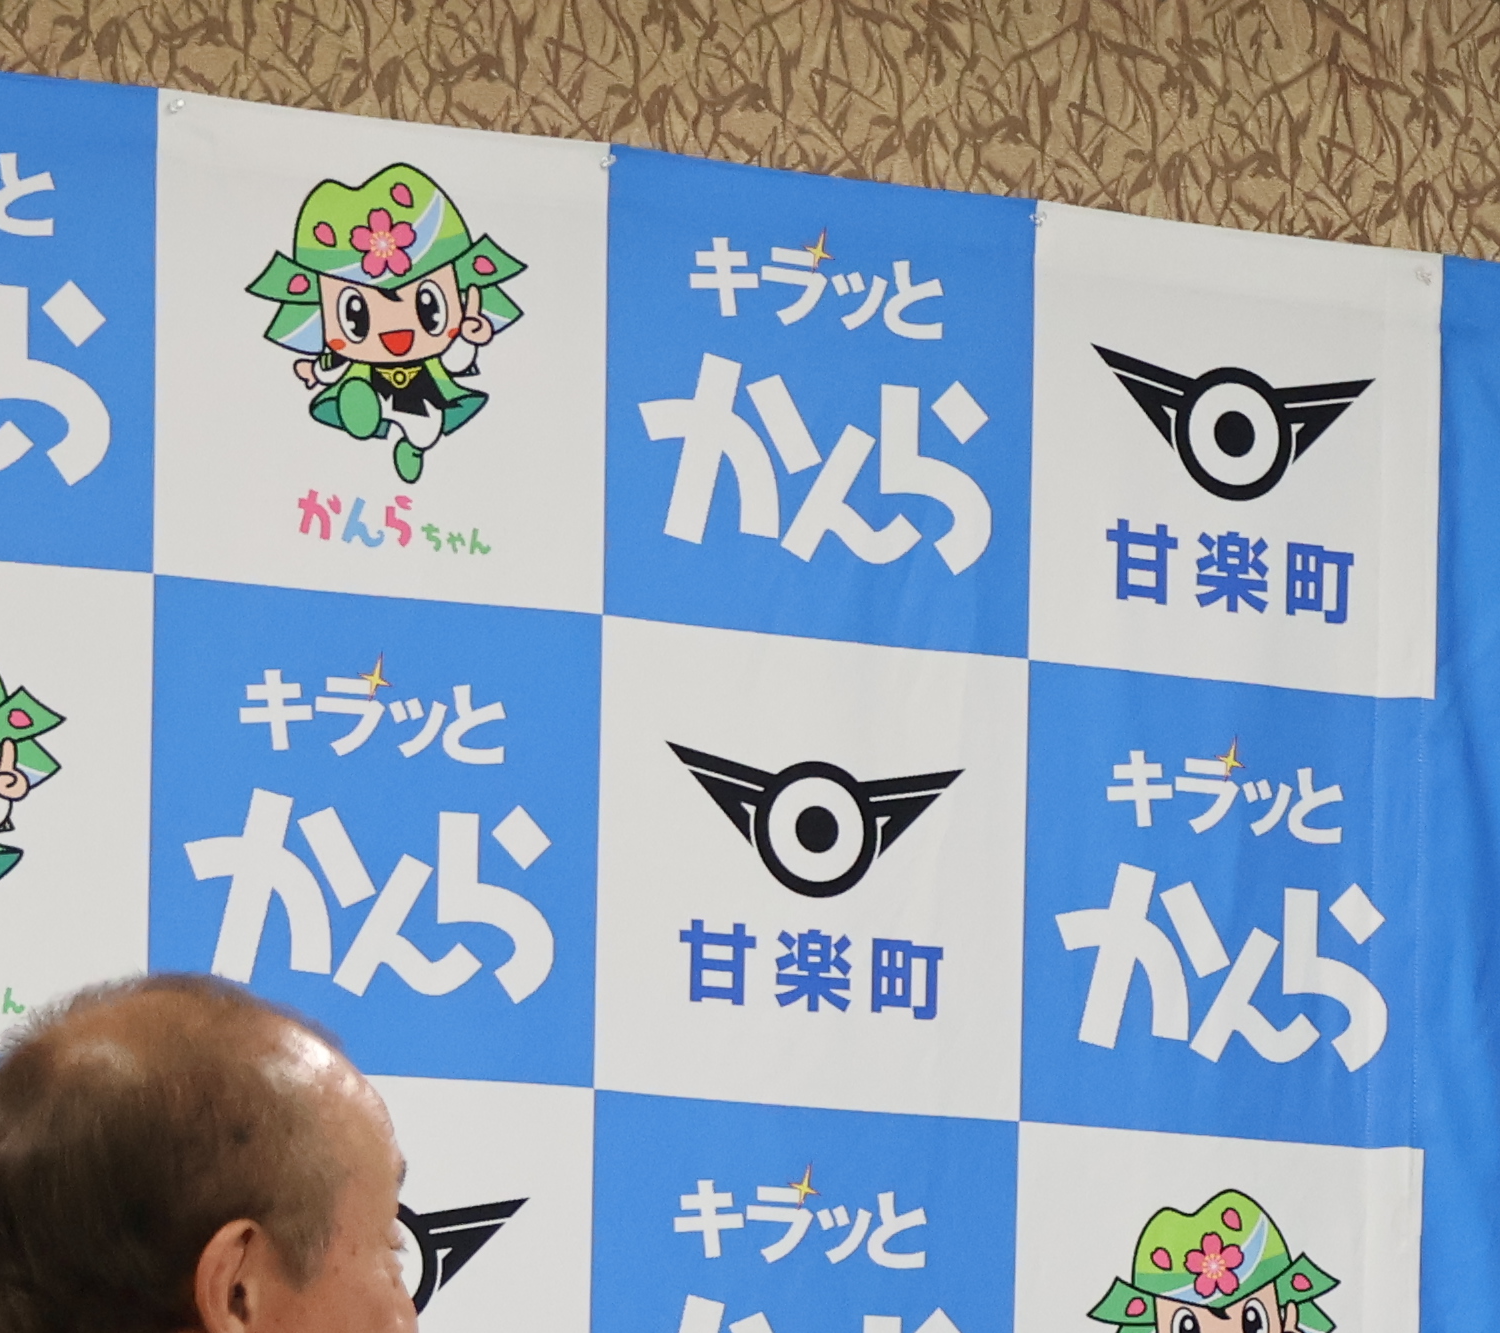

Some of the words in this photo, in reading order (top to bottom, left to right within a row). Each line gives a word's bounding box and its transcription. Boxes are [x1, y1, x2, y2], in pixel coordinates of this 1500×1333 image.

[690, 233, 943, 339] キラッと
[639, 353, 991, 574] かんら
[298, 490, 489, 553] かんらちゃん
[1107, 519, 1353, 623] 甘楽町
[240, 670, 505, 764] キラッと
[1107, 750, 1343, 843] キラッと
[185, 788, 554, 1004] かんら
[681, 920, 943, 1019] 甘楽町
[1056, 863, 1387, 1071] かんら
[674, 1179, 926, 1268] キラッと
